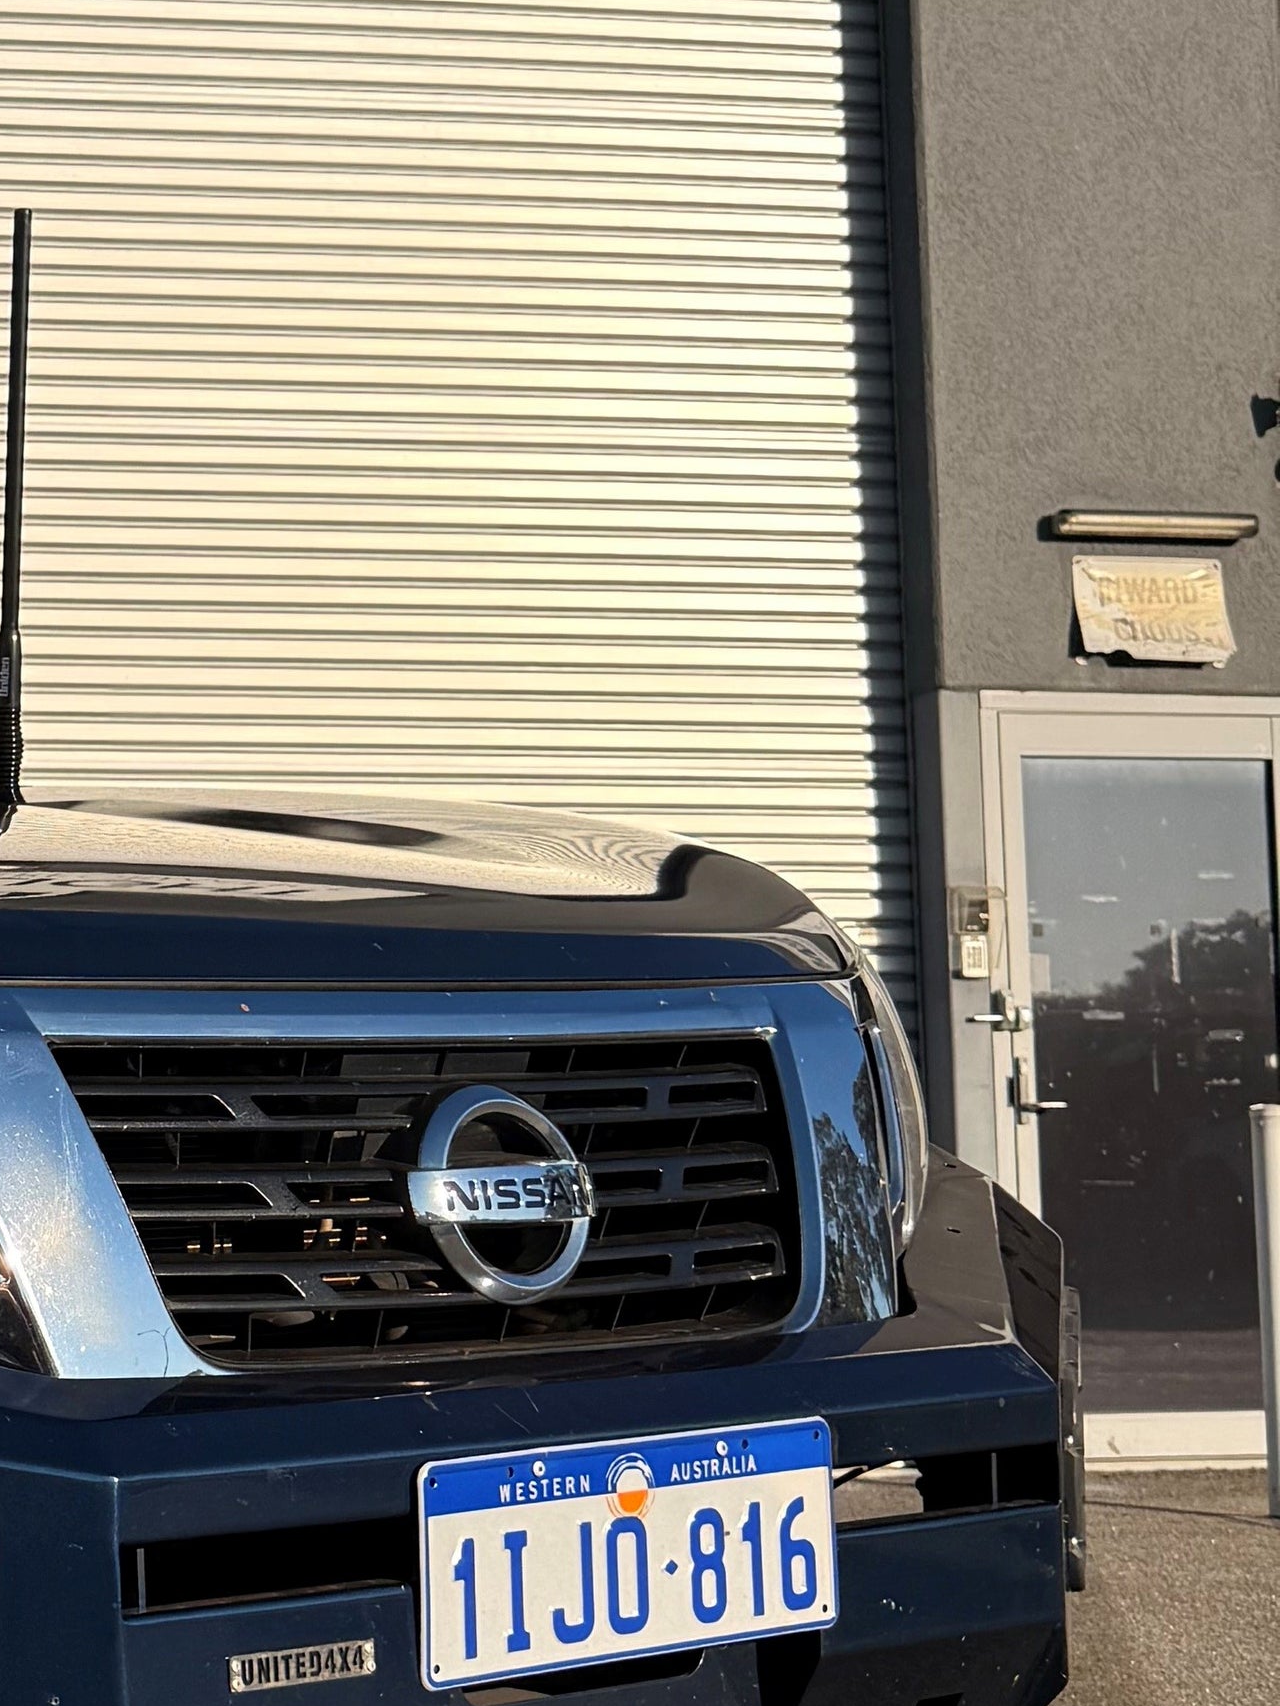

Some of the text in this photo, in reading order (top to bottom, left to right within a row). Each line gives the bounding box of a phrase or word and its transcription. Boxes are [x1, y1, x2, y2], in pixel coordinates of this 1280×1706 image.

[499, 1453, 758, 1504] WESTERN AUSTRALIA
[240, 1644, 365, 1687] UNITED4X4
